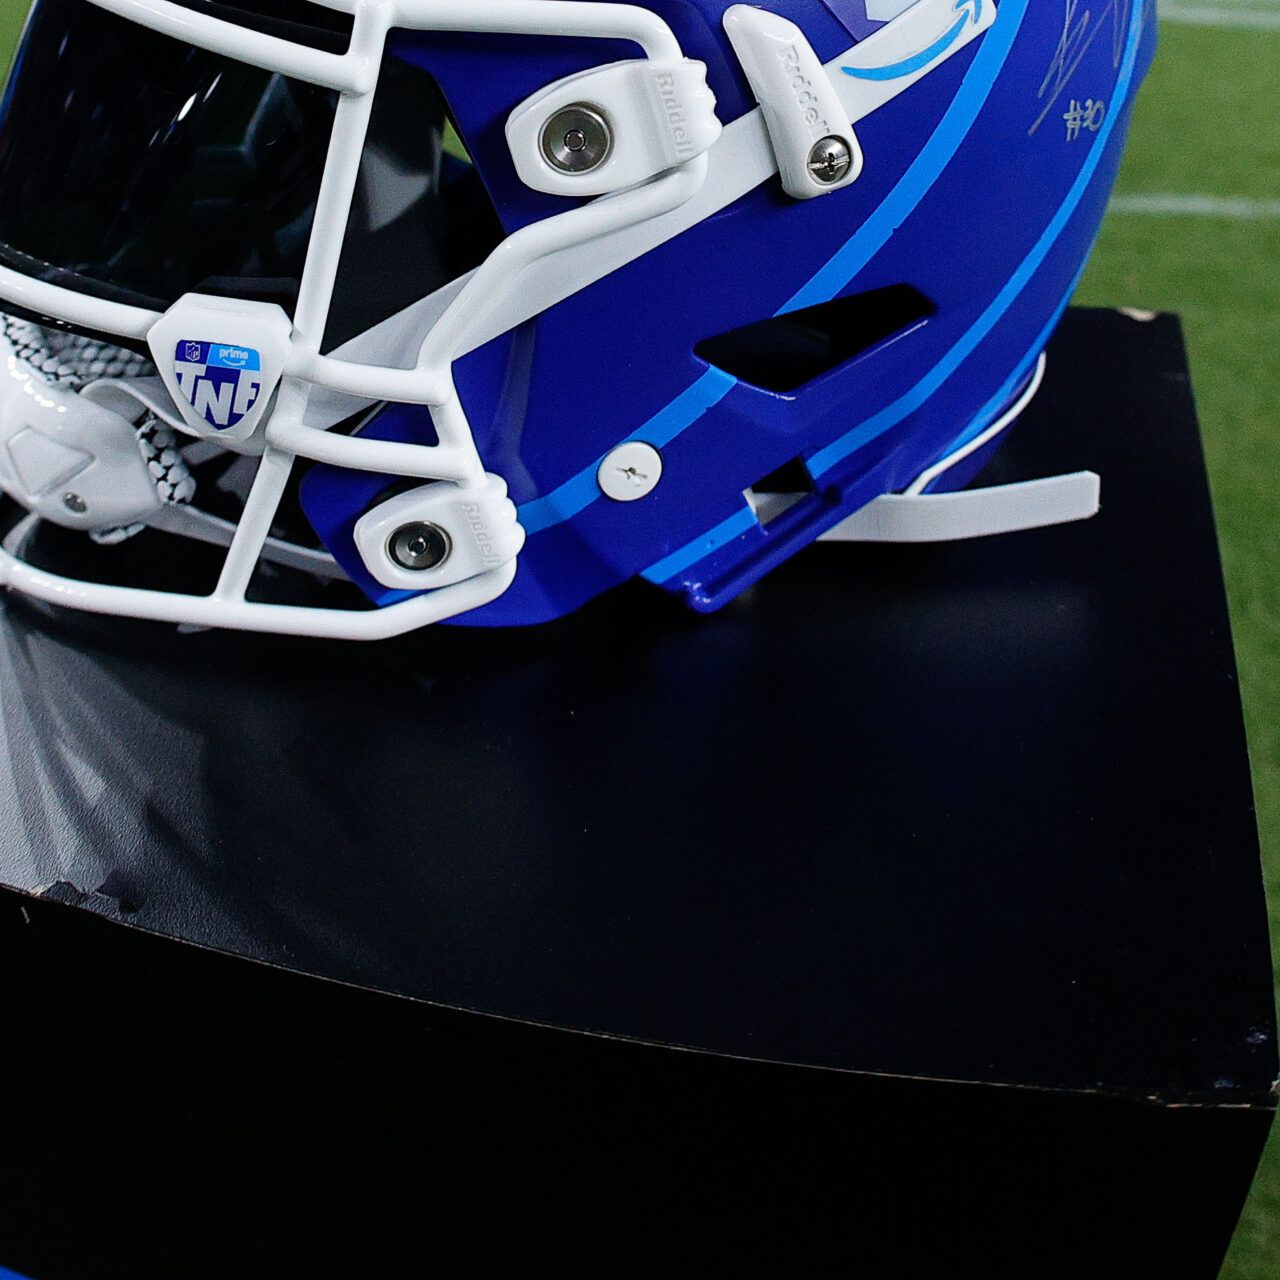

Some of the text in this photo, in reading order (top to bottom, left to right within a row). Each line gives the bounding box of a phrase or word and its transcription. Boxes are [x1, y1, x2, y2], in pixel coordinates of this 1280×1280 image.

[655, 70, 694, 156] Riddell
[219, 347, 249, 360] prime
[174, 360, 261, 426] TNF
